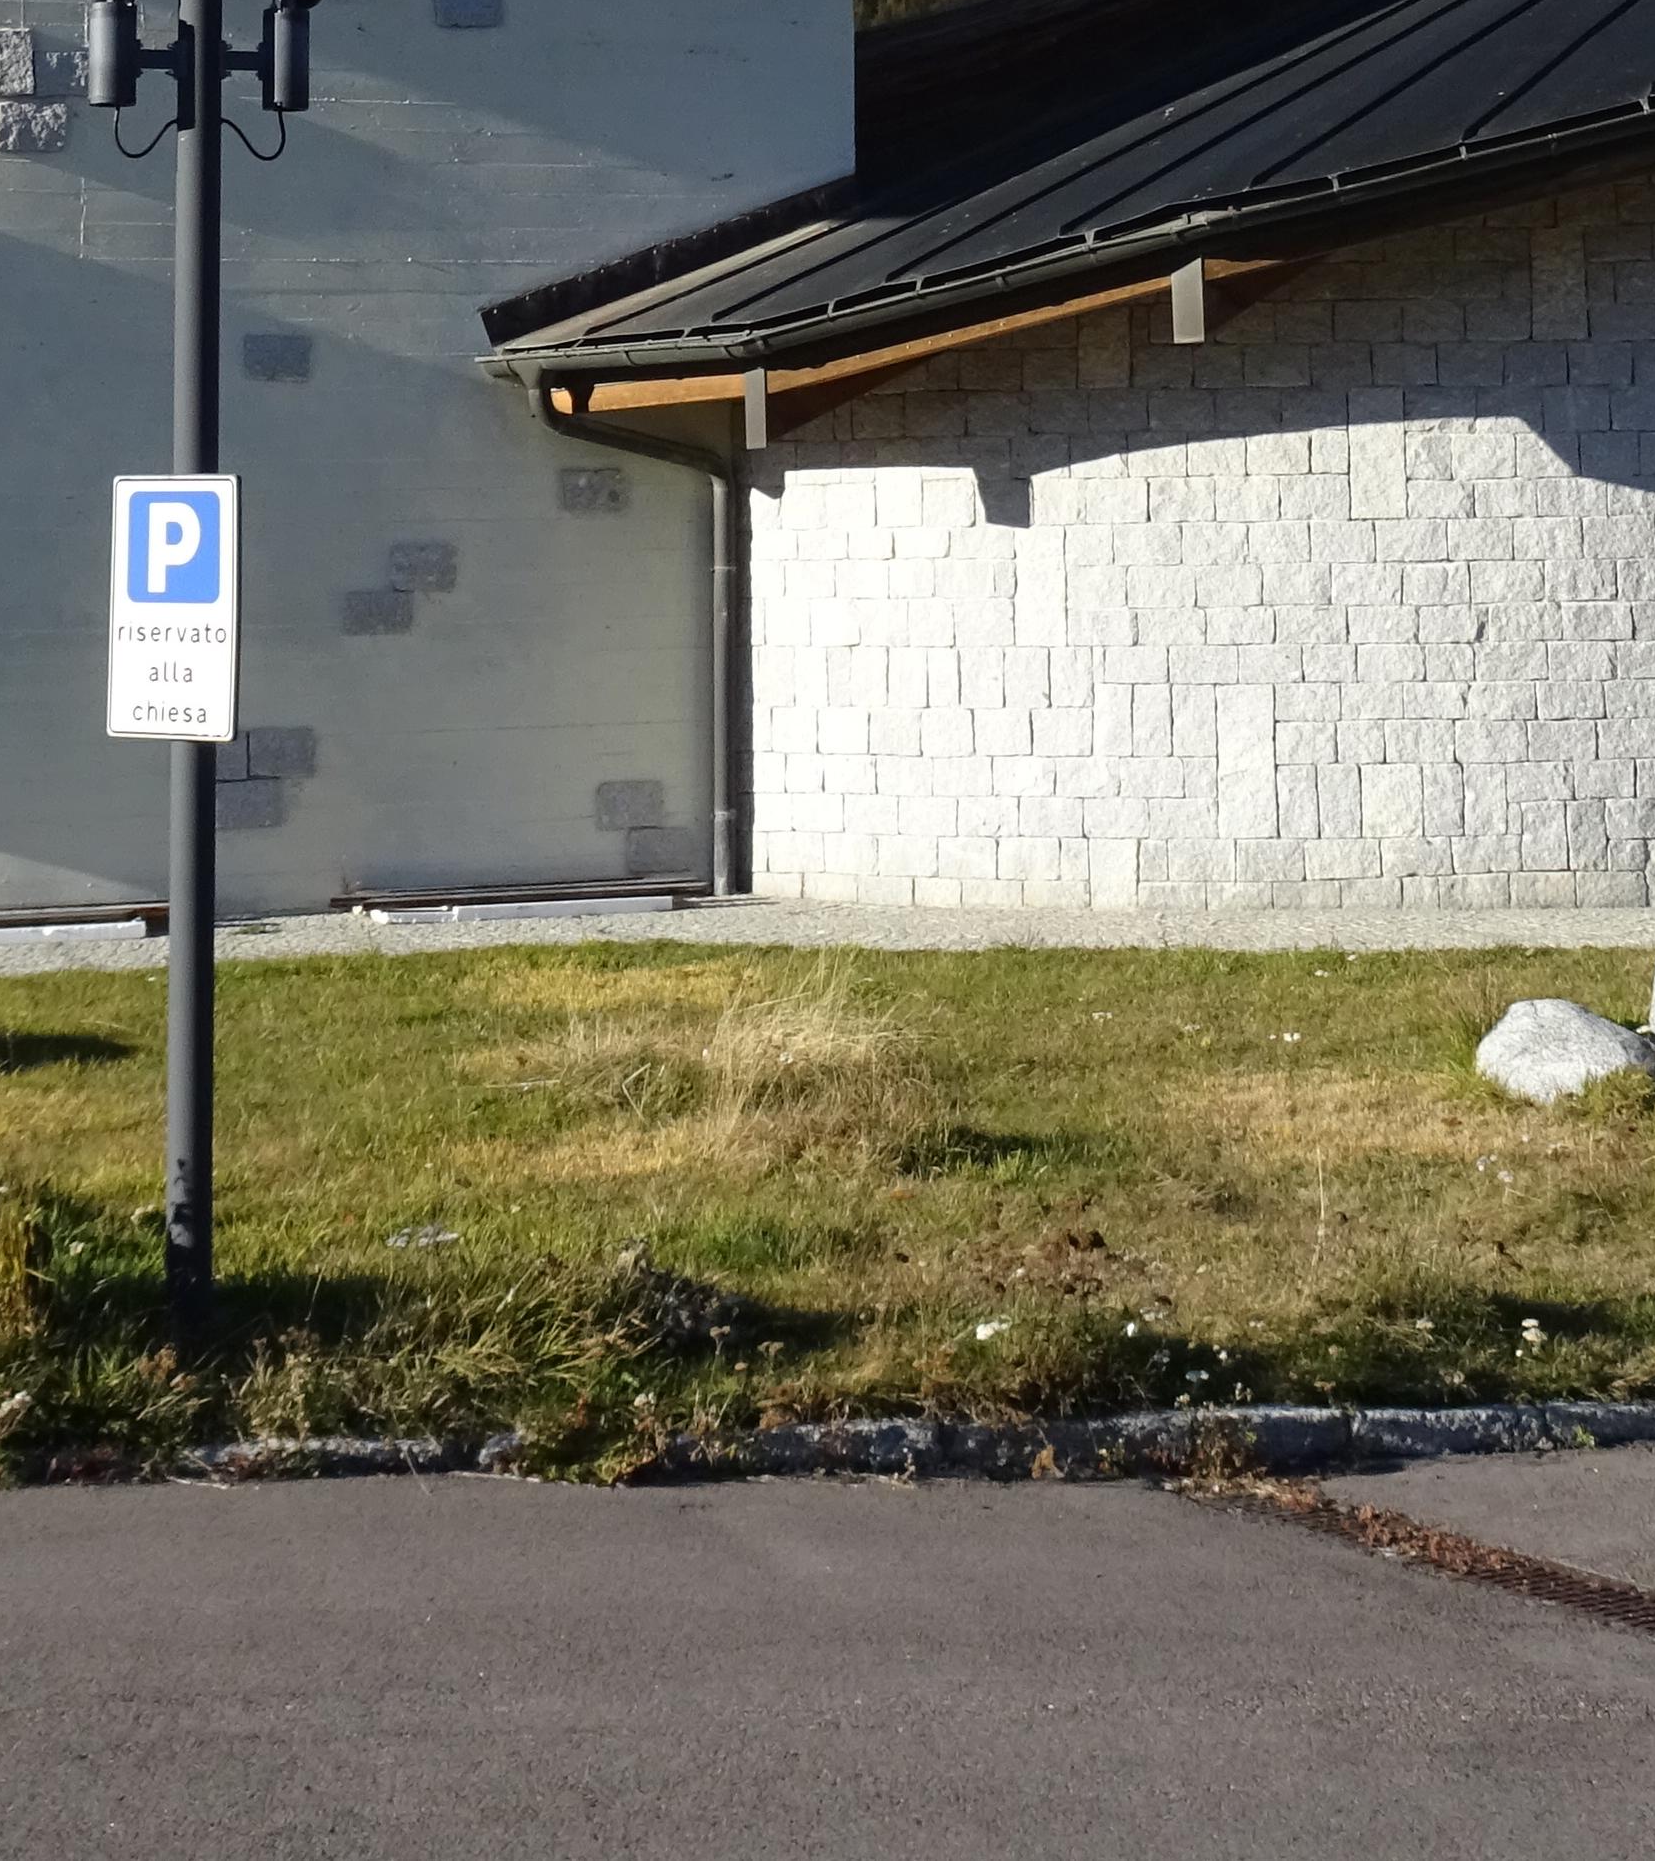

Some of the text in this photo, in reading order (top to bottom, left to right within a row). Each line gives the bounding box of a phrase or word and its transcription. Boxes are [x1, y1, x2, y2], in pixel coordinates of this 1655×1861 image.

[147, 502, 201, 593] P
[117, 621, 227, 644] riservato
[149, 661, 193, 683] alla
[132, 700, 207, 724] chiesa
